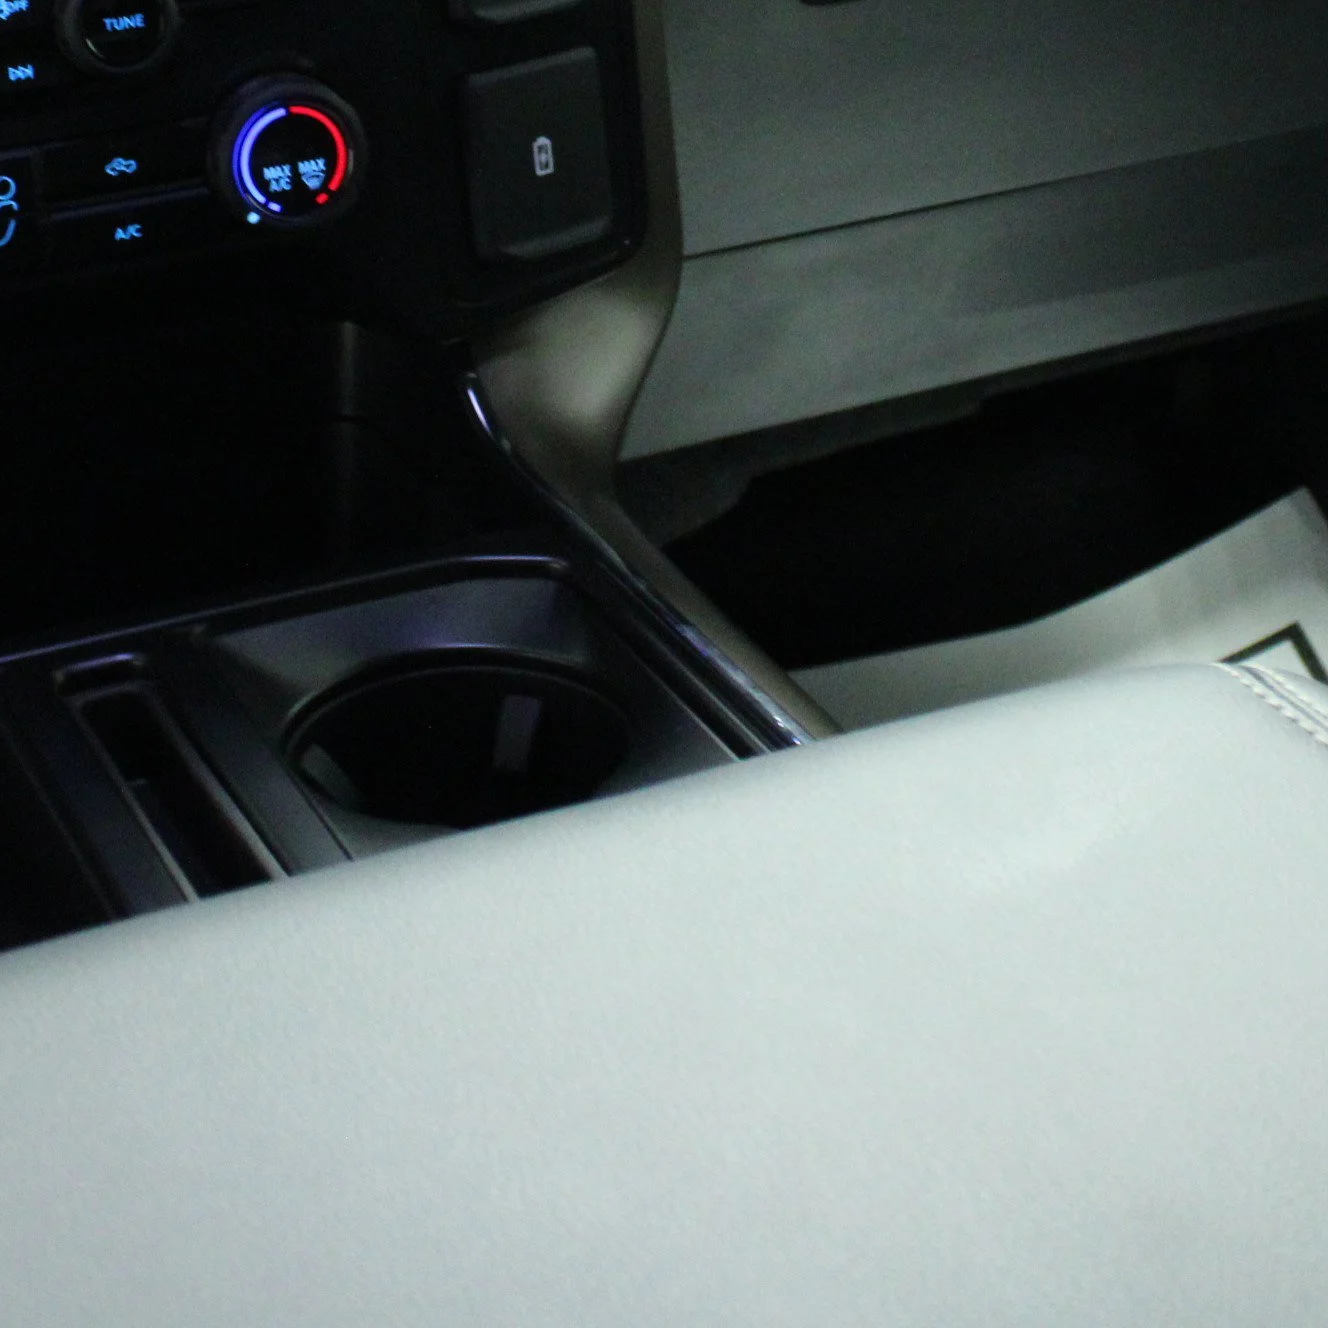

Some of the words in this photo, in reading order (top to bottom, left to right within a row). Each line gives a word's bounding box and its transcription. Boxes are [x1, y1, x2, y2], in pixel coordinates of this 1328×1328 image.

[102, 12, 145, 32] TUNE
[263, 164, 293, 180] MAX
[297, 158, 327, 174] MAX
[114, 223, 143, 241] A/C
